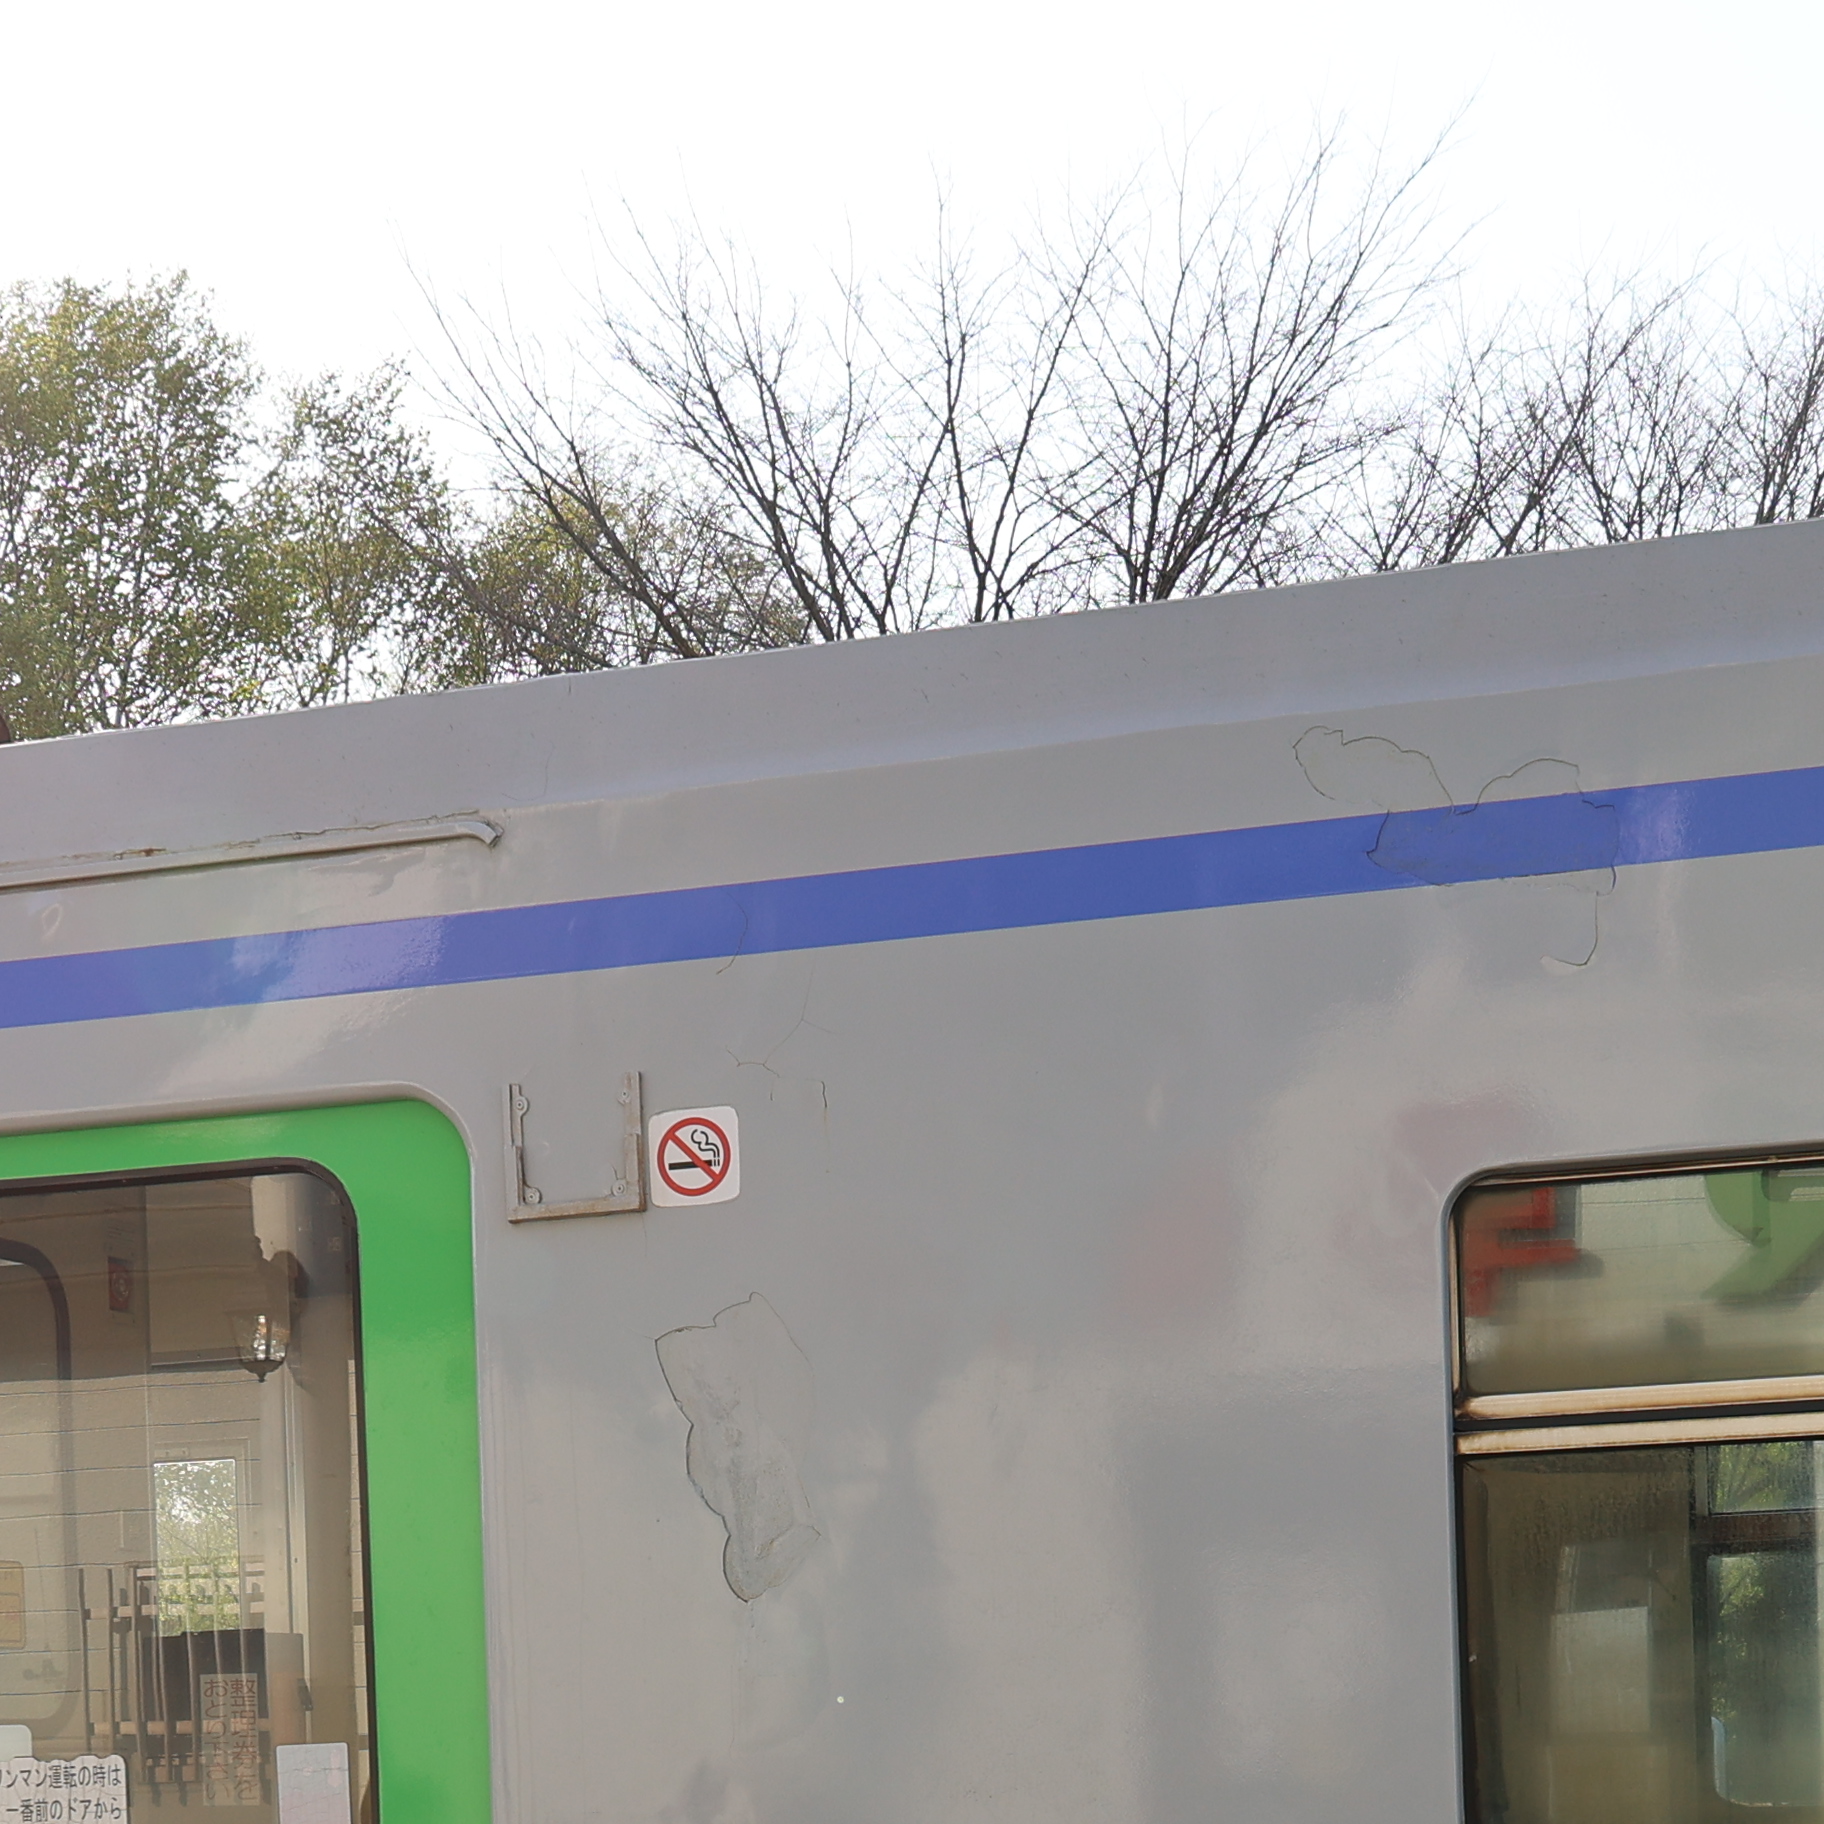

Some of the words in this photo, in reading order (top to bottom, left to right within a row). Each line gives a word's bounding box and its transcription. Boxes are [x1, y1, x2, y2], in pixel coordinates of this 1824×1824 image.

[6, 1797, 122, 1822] 一番前のドアから
